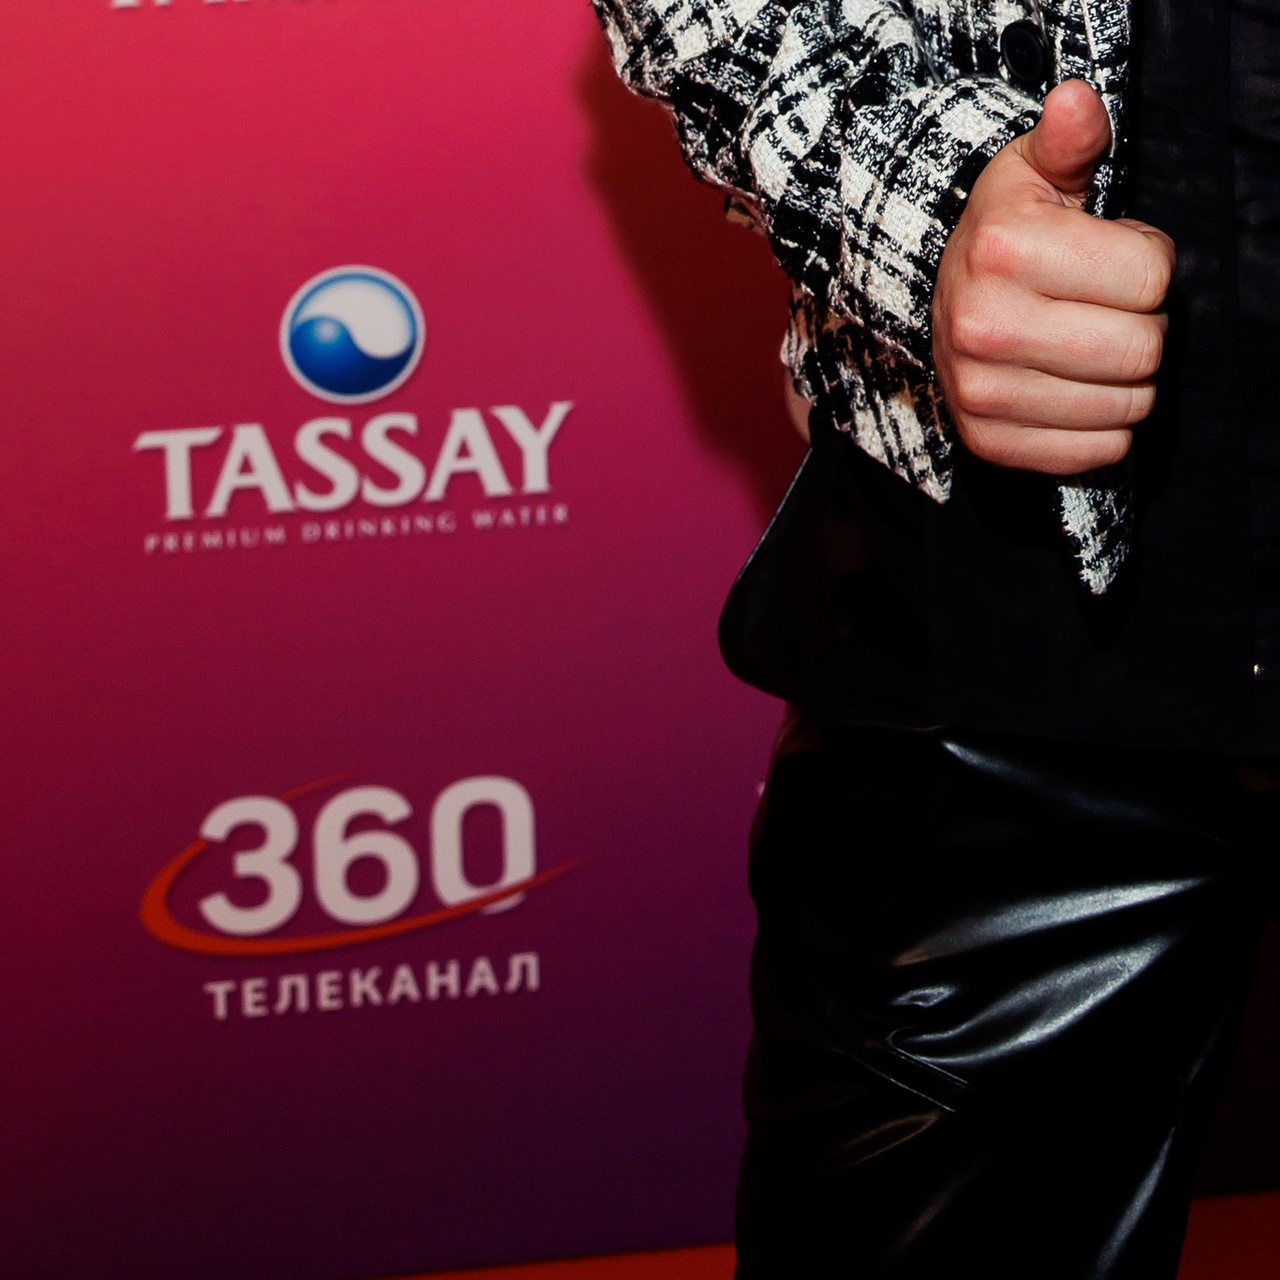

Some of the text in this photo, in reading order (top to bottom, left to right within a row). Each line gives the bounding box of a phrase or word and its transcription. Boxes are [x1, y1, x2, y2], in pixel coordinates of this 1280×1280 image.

[133, 400, 573, 521] TASSAY
[143, 503, 569, 555] PREMIUM DRINKING WATER
[199, 775, 536, 936] 360
[205, 951, 540, 1020] ТЕЛЕКАНАЛ
